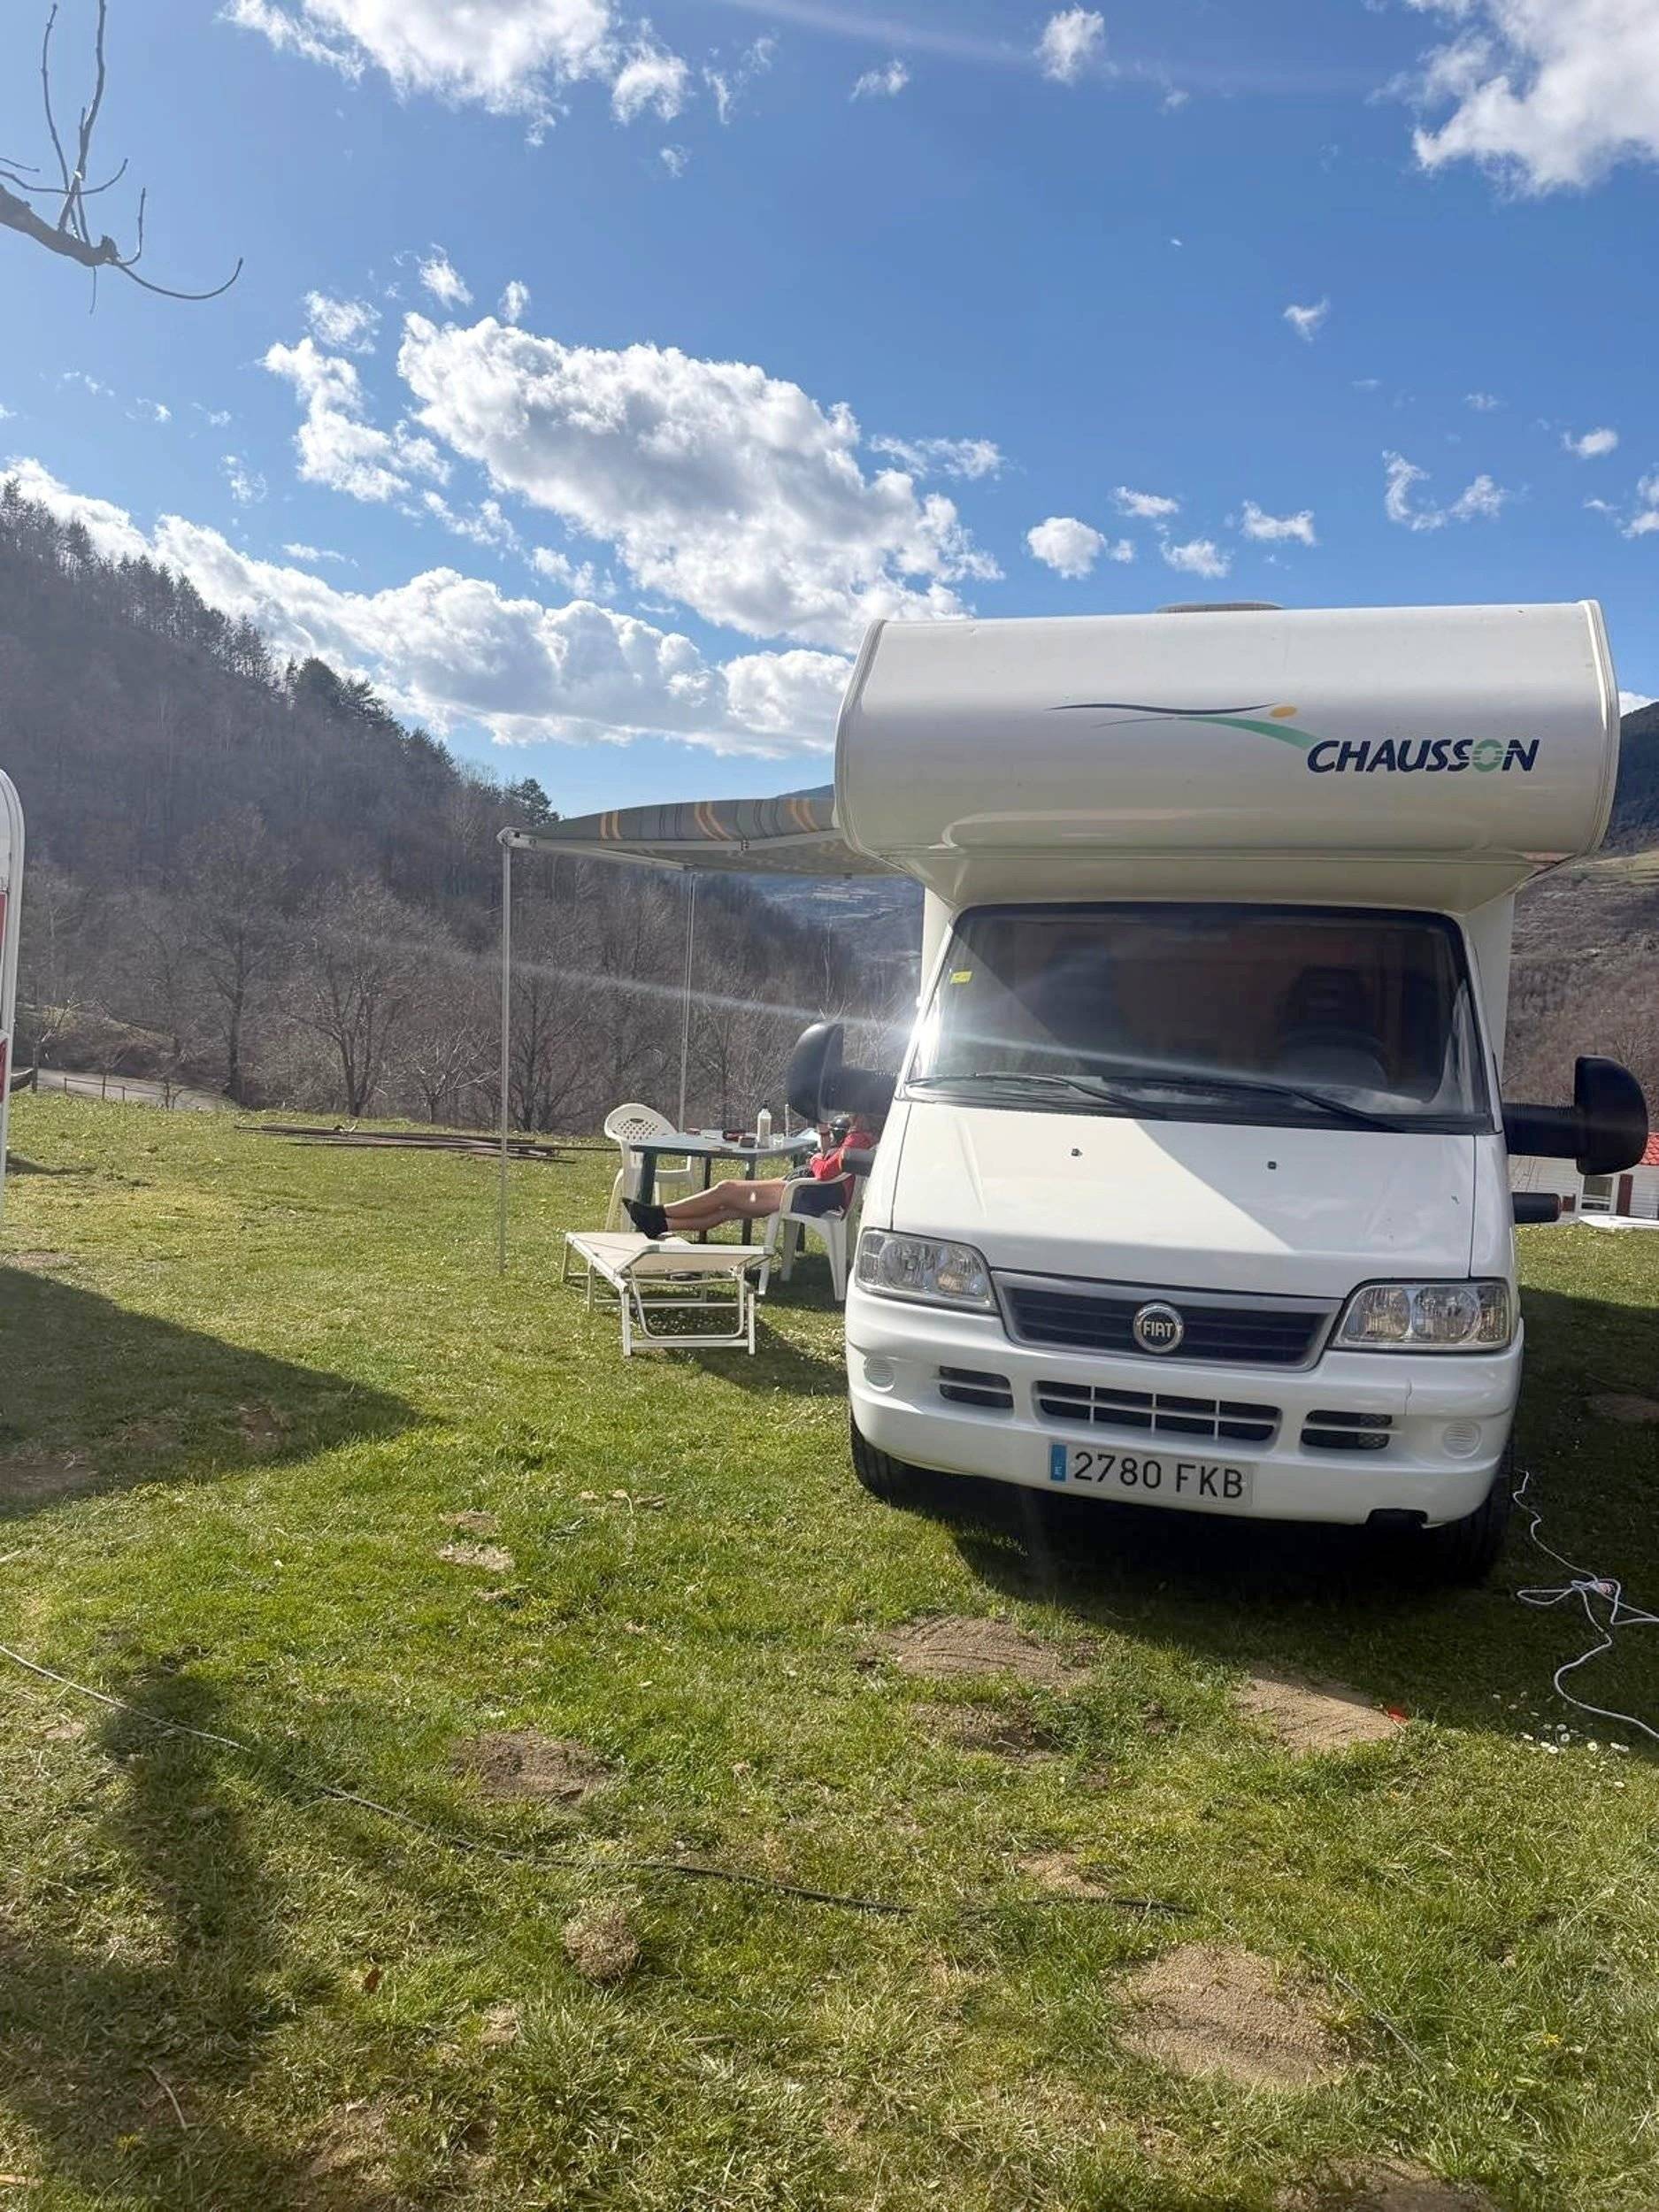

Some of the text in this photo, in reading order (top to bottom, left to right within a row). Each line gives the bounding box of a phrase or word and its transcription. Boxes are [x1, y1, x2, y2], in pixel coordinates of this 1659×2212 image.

[1307, 738, 1540, 773] CHAUSSON
[1143, 1321, 1173, 1338] FIAT
[1073, 1451, 1243, 1499] 2780 FKB
